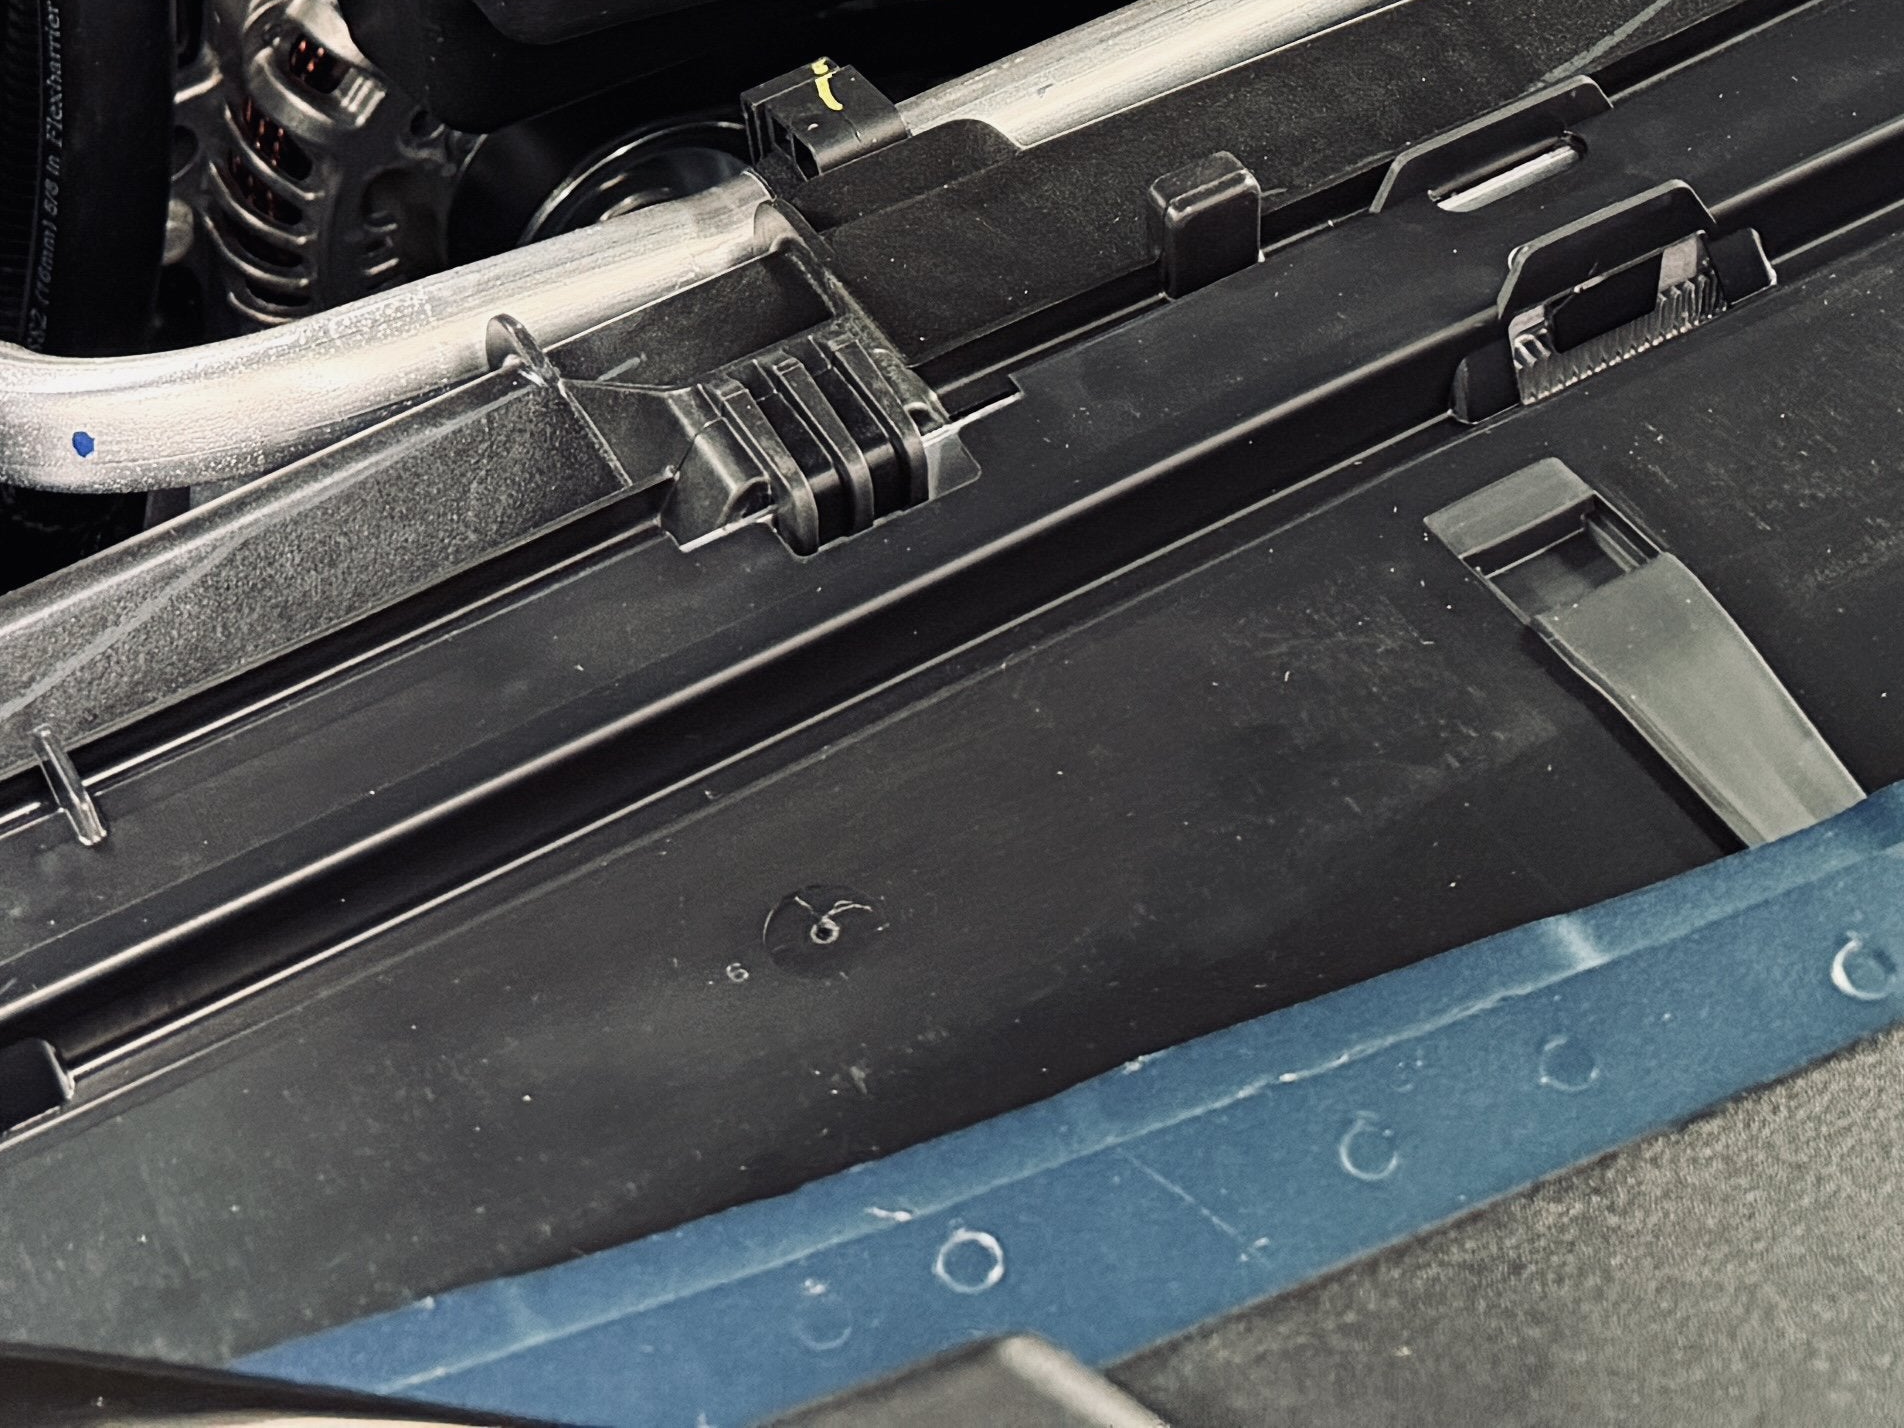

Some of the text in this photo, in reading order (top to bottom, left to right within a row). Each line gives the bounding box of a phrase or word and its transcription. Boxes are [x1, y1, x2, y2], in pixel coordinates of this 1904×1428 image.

[43, 0, 64, 148] Flexbarrier
[45, 154, 61, 176] in
[44, 179, 60, 216] 5/8
[34, 220, 58, 305] (16mm)
